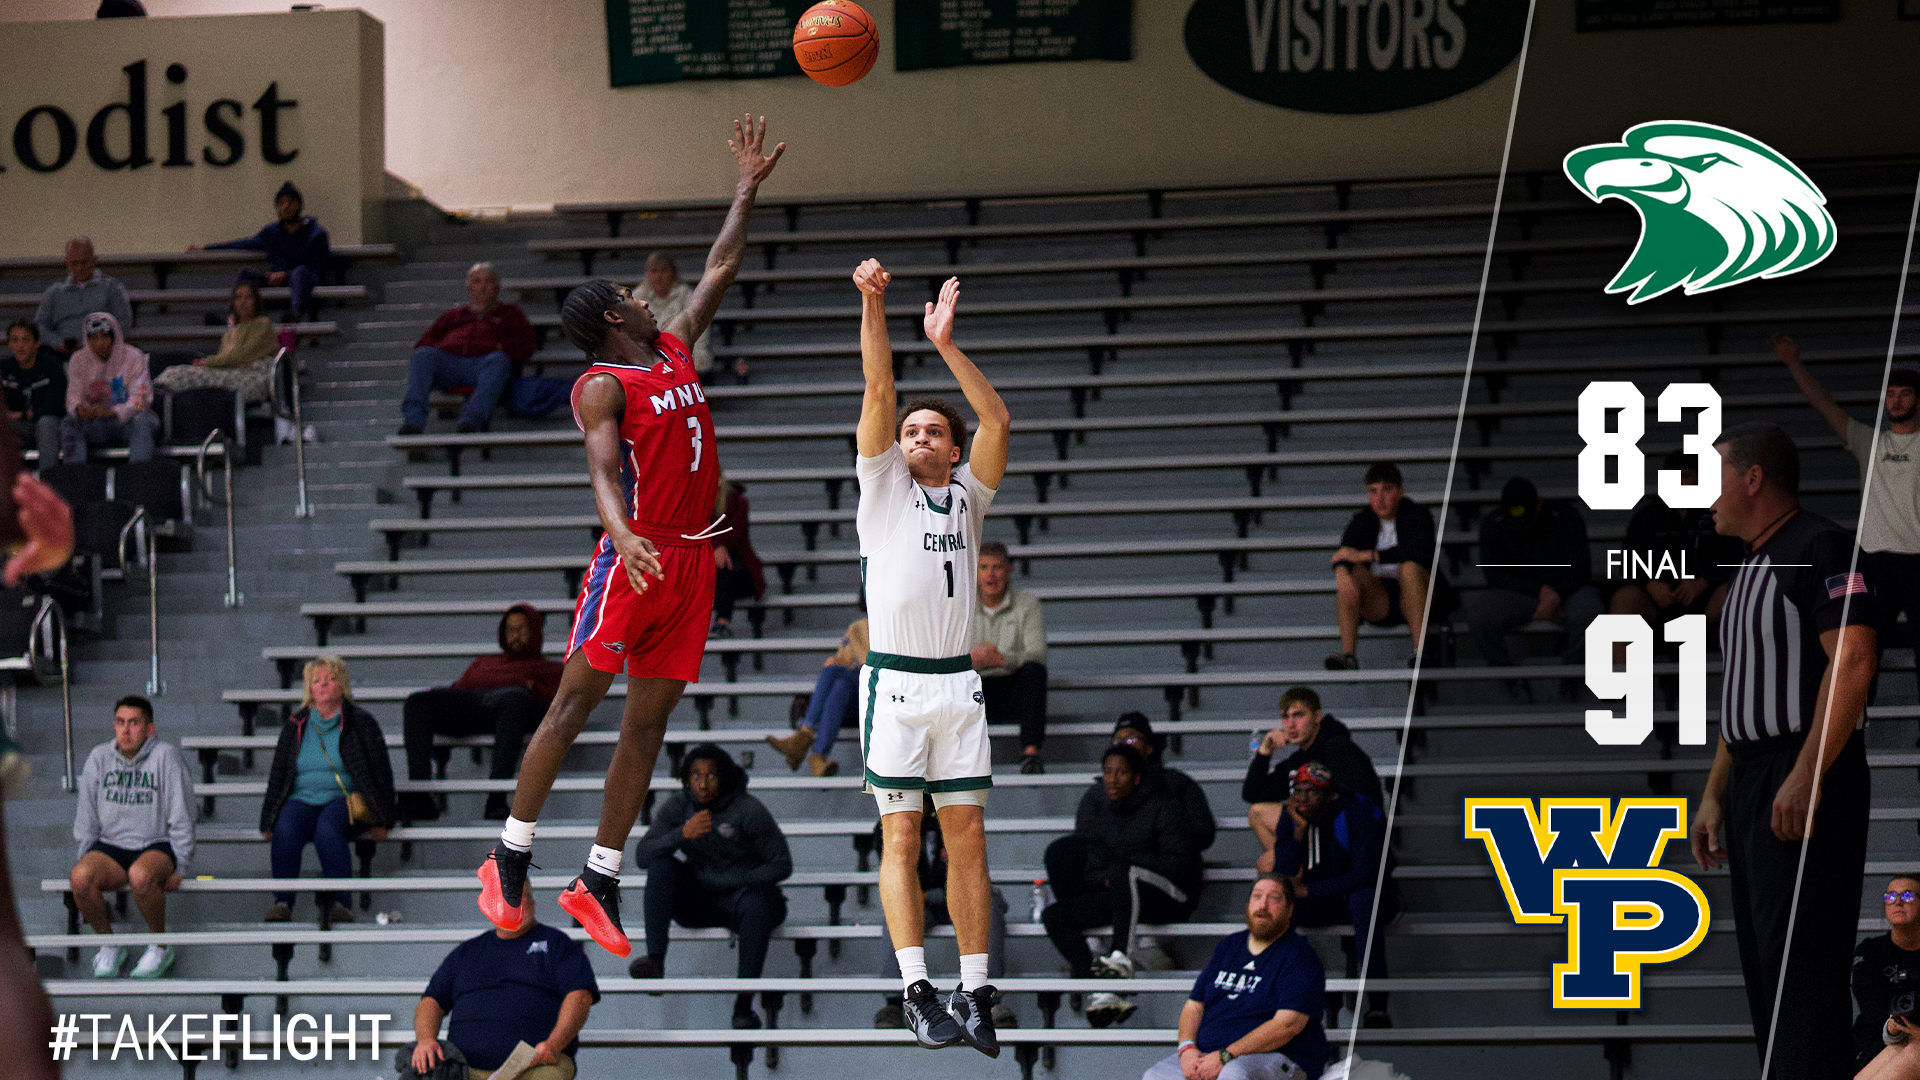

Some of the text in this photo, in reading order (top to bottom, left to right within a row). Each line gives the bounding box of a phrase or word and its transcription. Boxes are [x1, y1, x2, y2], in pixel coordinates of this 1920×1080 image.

[1246, 0, 1467, 72] VISITORS
[0, 59, 299, 174] odist
[648, 381, 705, 416] MNU
[686, 416, 702, 473] 3
[944, 561, 954, 598] 1
